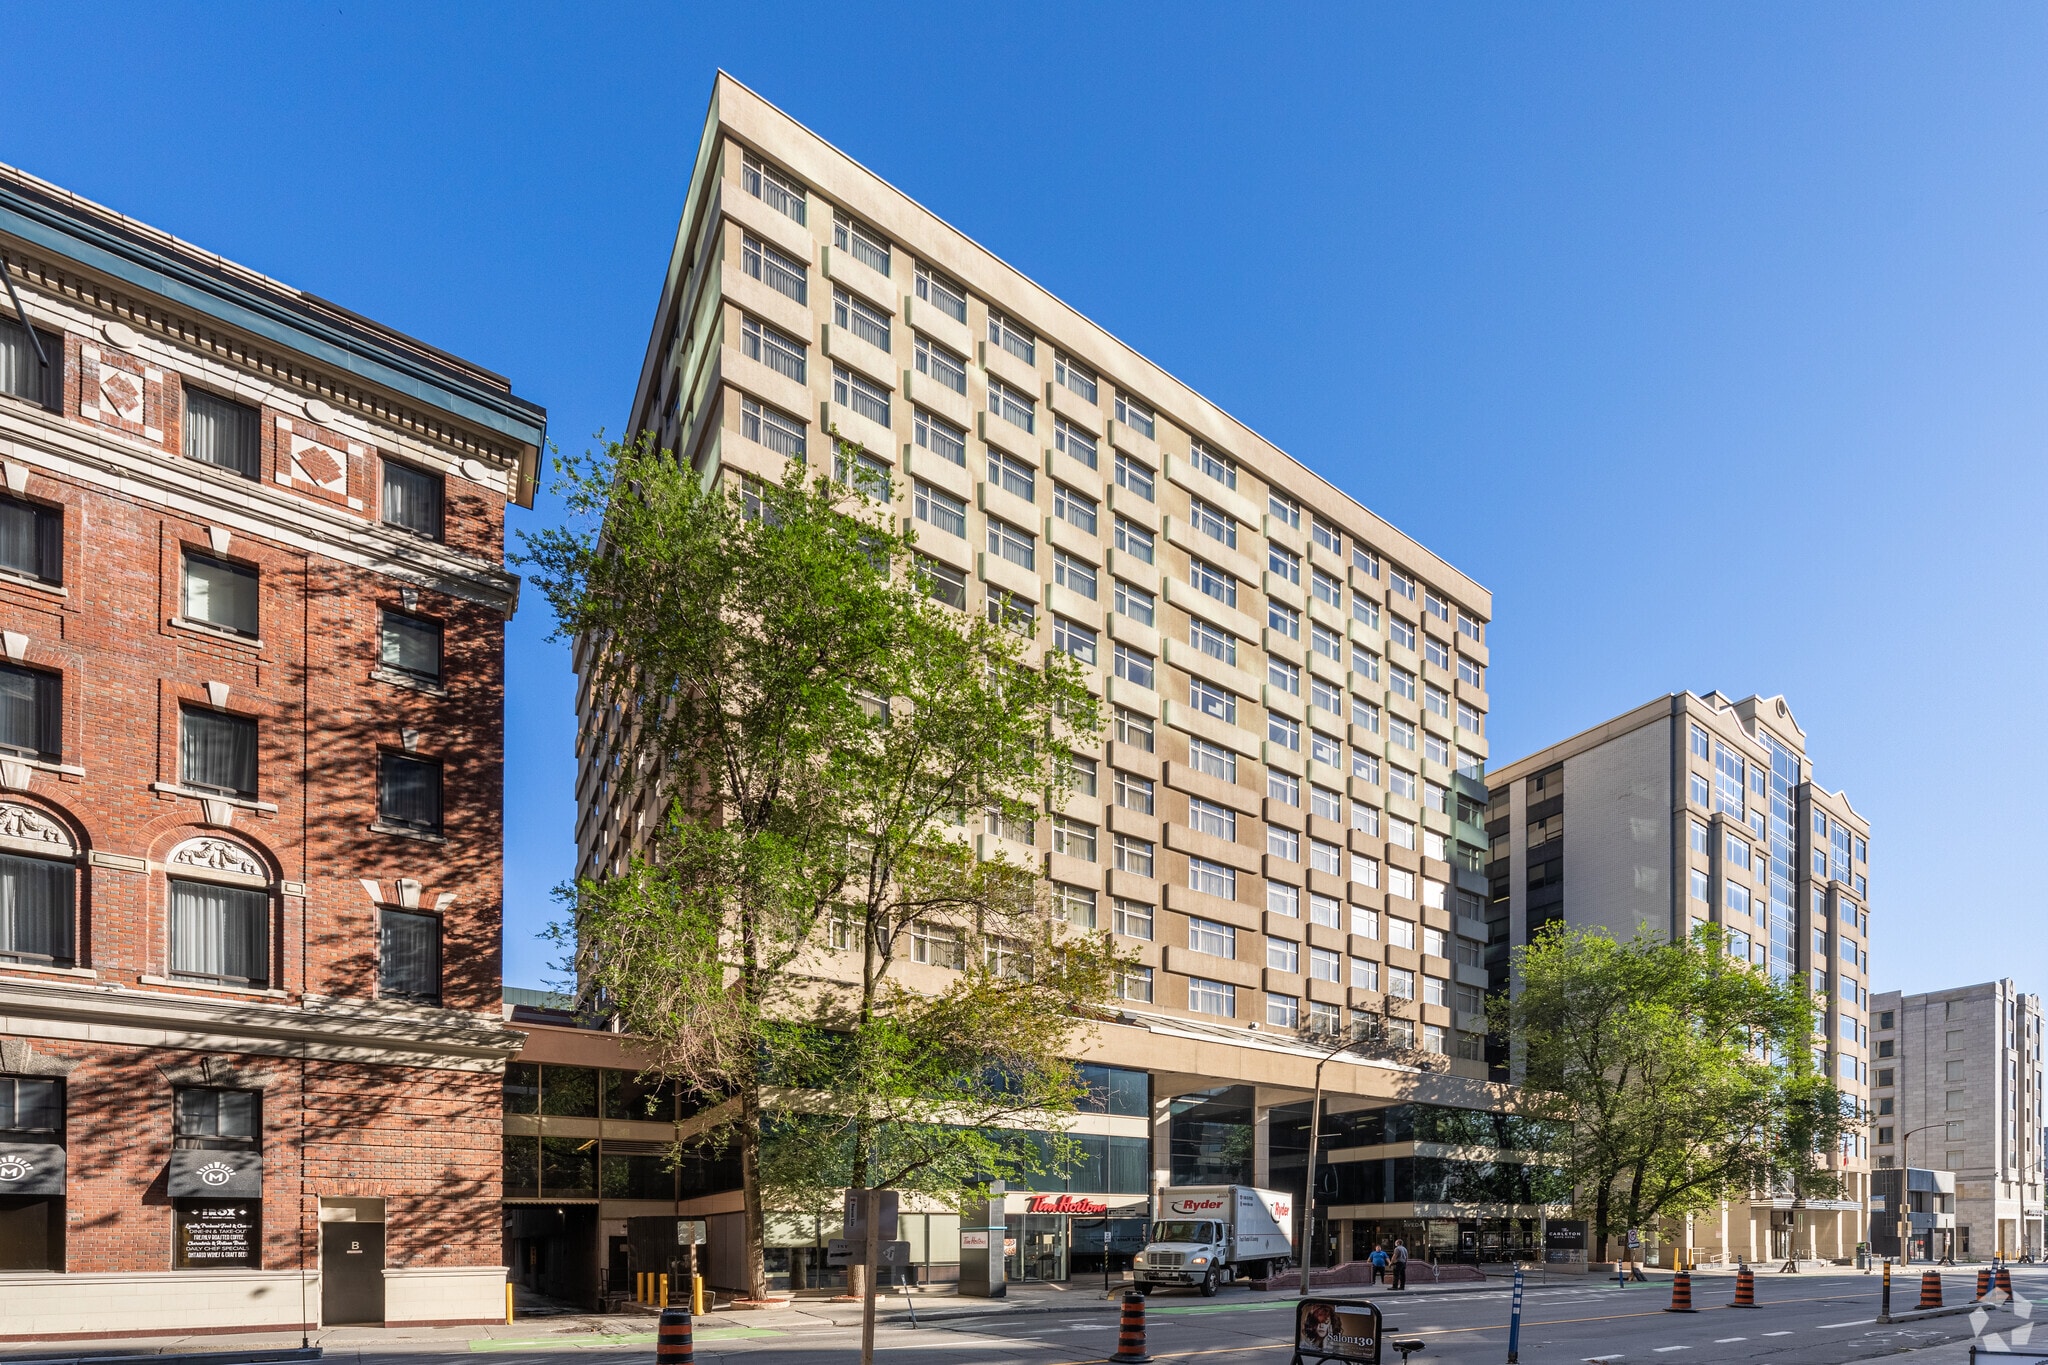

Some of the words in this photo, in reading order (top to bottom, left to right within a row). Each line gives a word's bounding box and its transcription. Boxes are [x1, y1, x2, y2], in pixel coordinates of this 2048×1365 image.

[1, 1167, 18, 1177] M
[208, 1172, 223, 1182] M
[1030, 1195, 1057, 1213] Tim
[1058, 1194, 1107, 1213] Hortons
[1183, 1199, 1224, 1211] Ryder
[1274, 1201, 1290, 1218] Ryder
[351, 1241, 360, 1250] B
[971, 1236, 986, 1245] Hortons
[1327, 1332, 1374, 1347] Salon130
